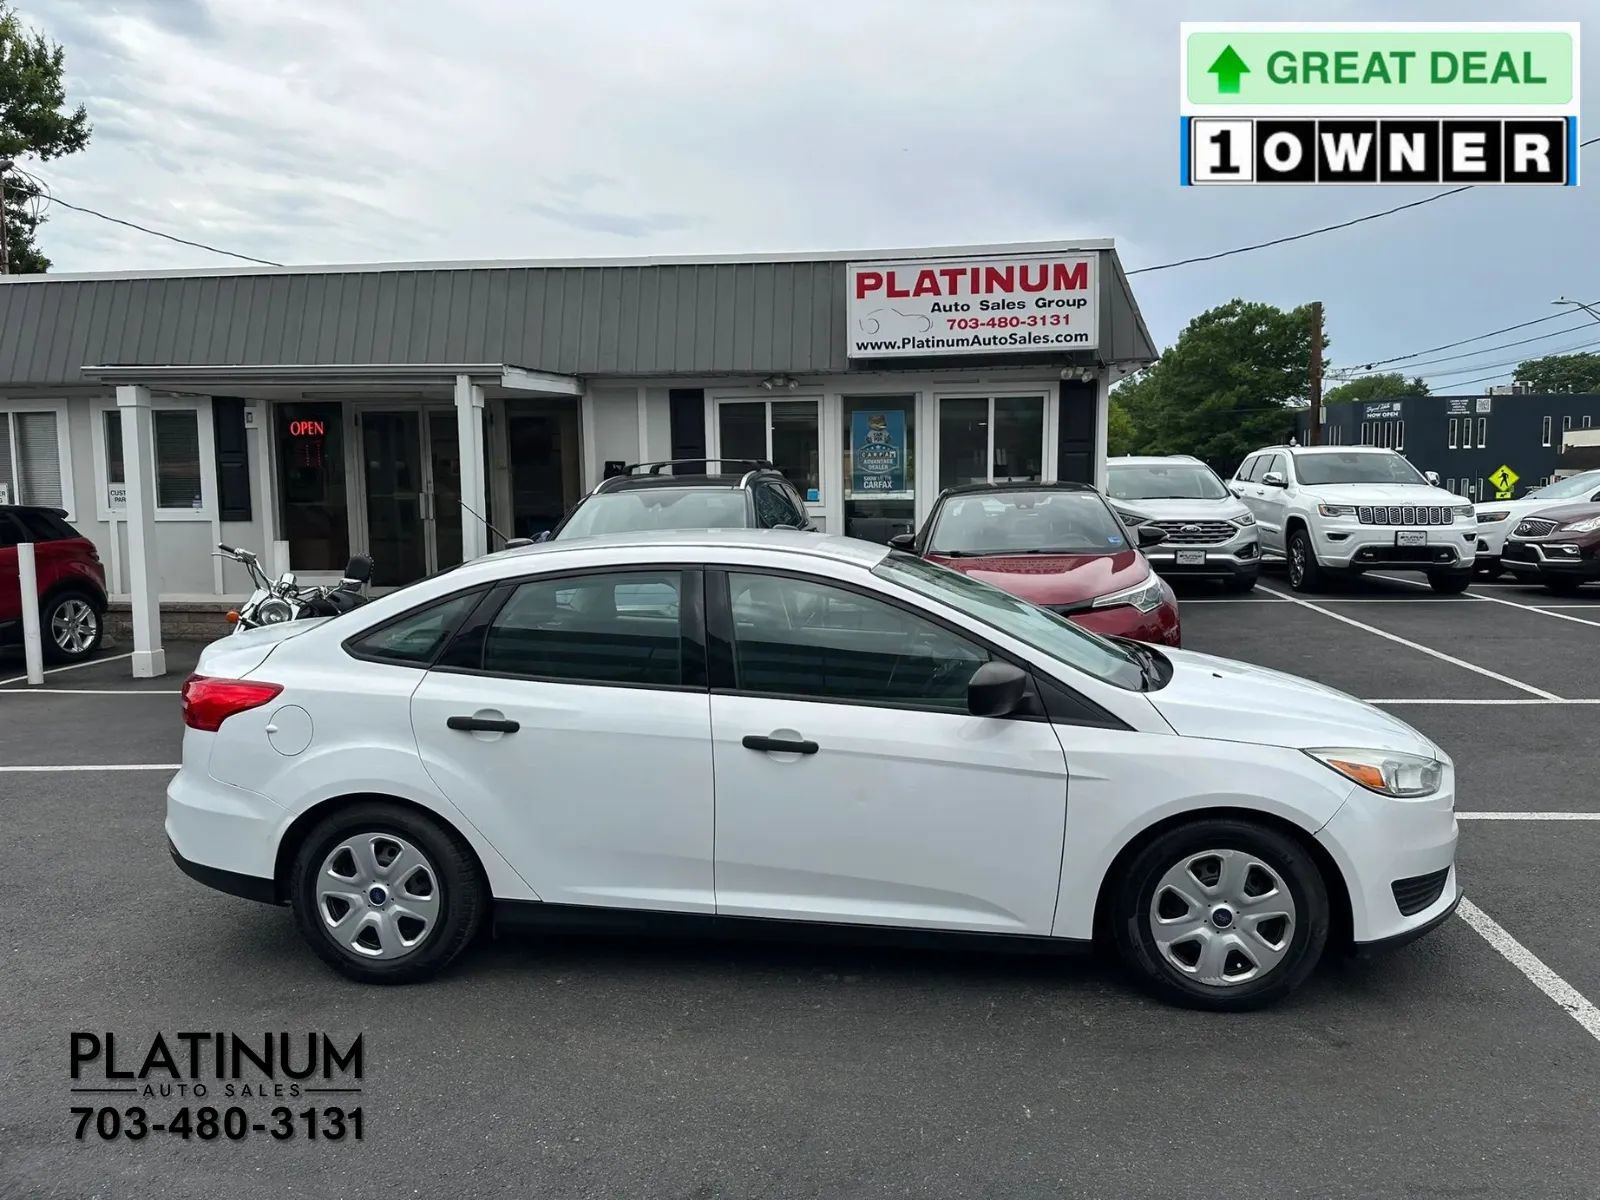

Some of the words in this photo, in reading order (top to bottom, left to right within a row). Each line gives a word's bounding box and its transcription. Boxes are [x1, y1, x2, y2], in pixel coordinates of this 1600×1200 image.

[856, 262, 1088, 299] PLATINUM
[930, 302, 971, 313] Auto
[979, 299, 1026, 311] Sales
[1034, 297, 1088, 310] Group
[946, 314, 1071, 330] 703-480-3131
[856, 332, 1089, 351] www.PlatinumAutoSales.com
[290, 421, 324, 436] OPEN
[863, 481, 893, 489] CARFAX
